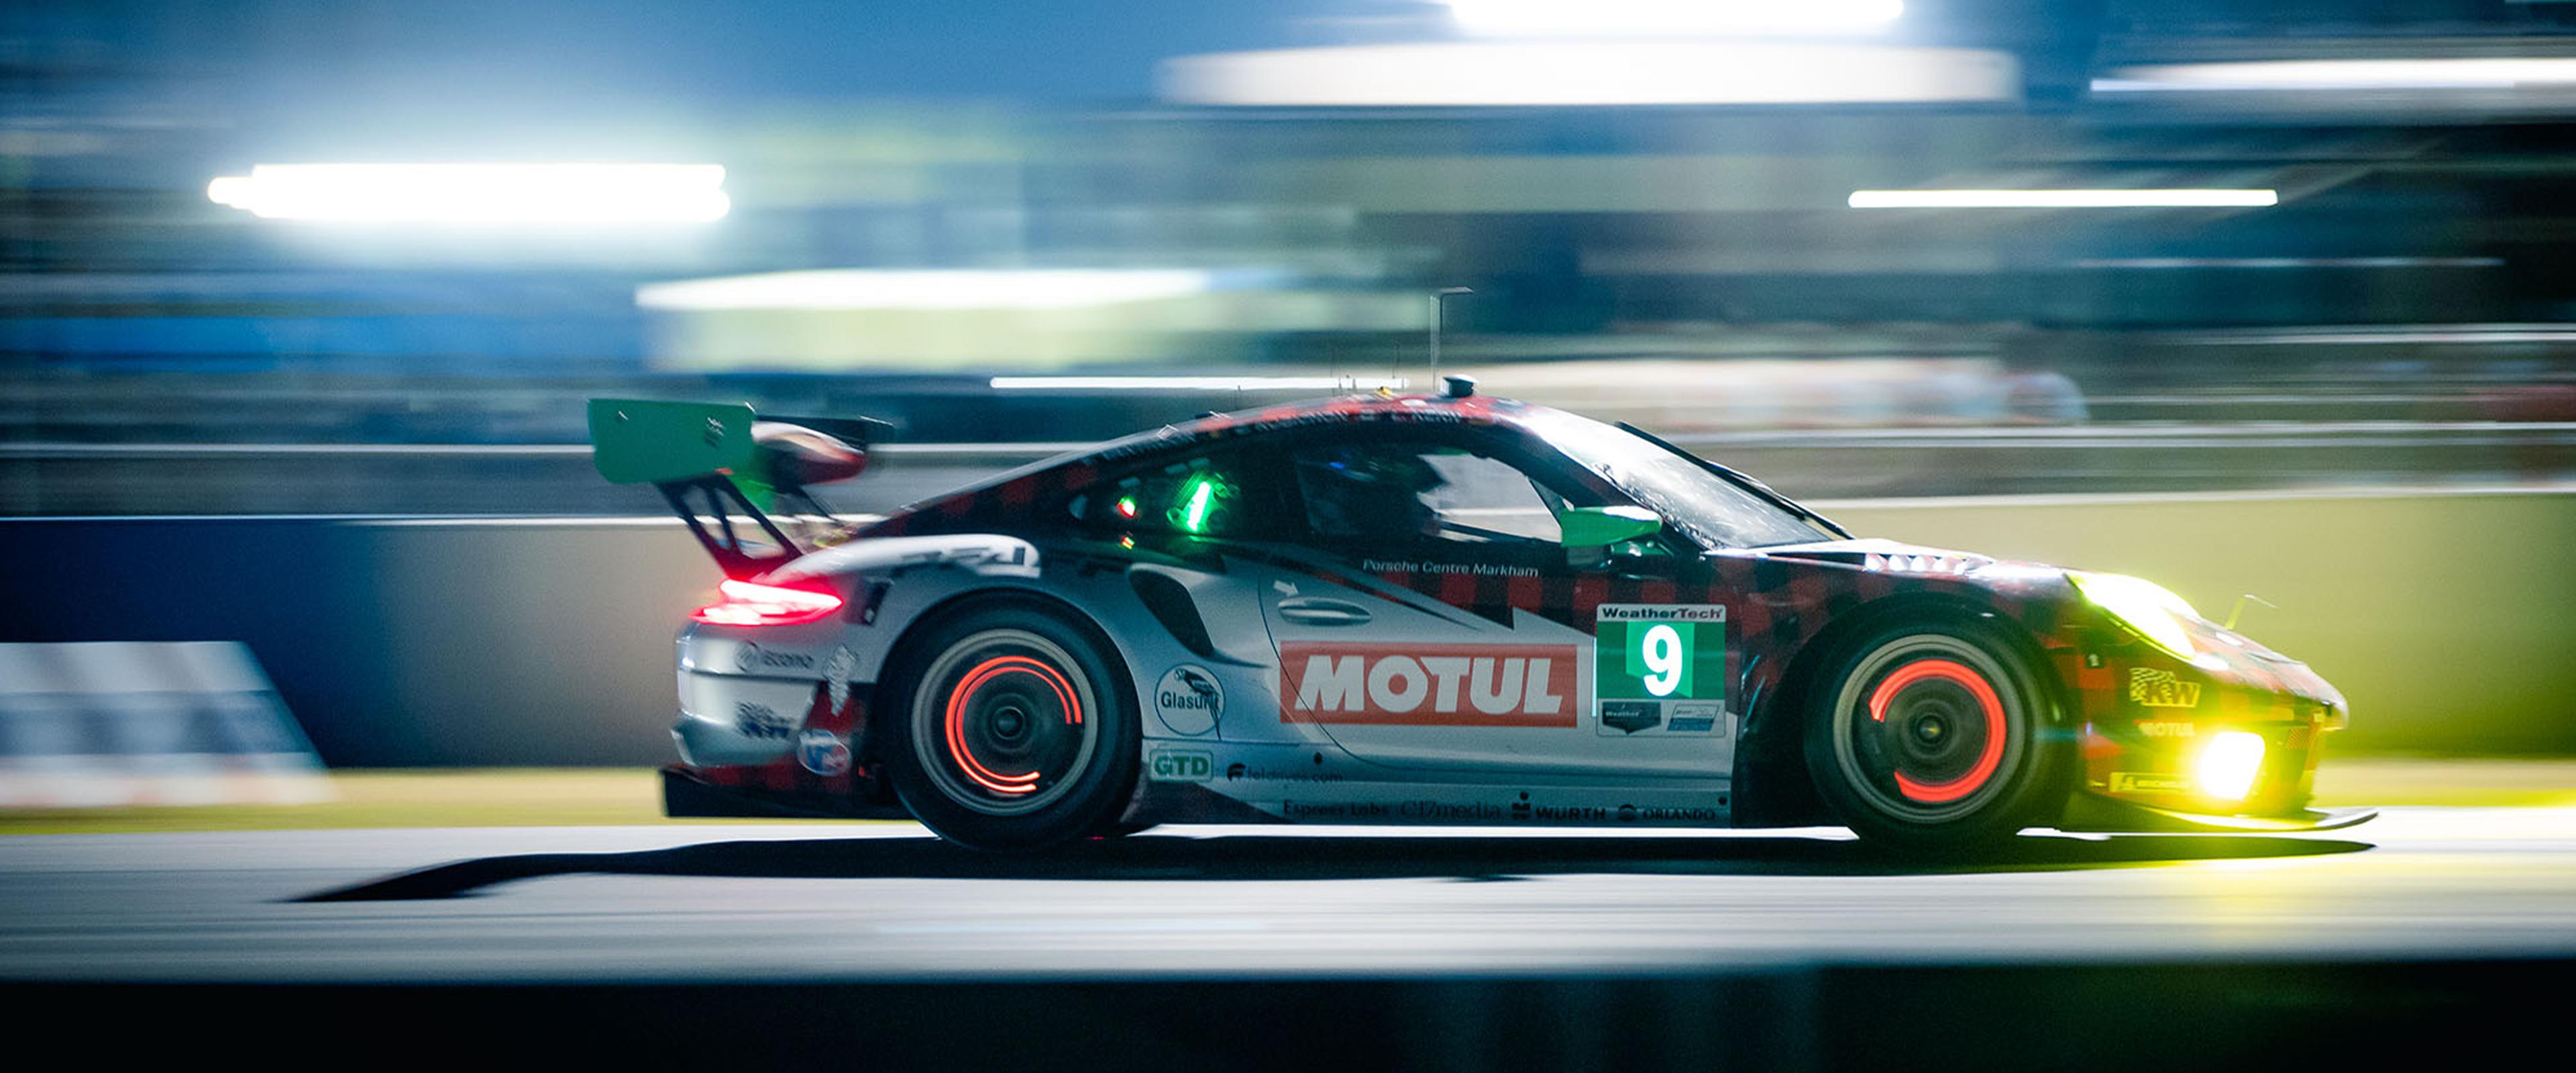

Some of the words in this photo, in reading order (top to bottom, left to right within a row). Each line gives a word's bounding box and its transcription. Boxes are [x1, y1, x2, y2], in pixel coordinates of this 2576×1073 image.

[1363, 559, 1419, 571] Porsche
[1422, 561, 1469, 574] Centre
[1473, 563, 1539, 578] Markham
[1602, 608, 1721, 618] WeatherTech
[1642, 624, 1683, 697] 9
[1295, 655, 1562, 714] MOTUL
[1155, 756, 1208, 776] GTD
[1644, 808, 1715, 821] ORLANDO
